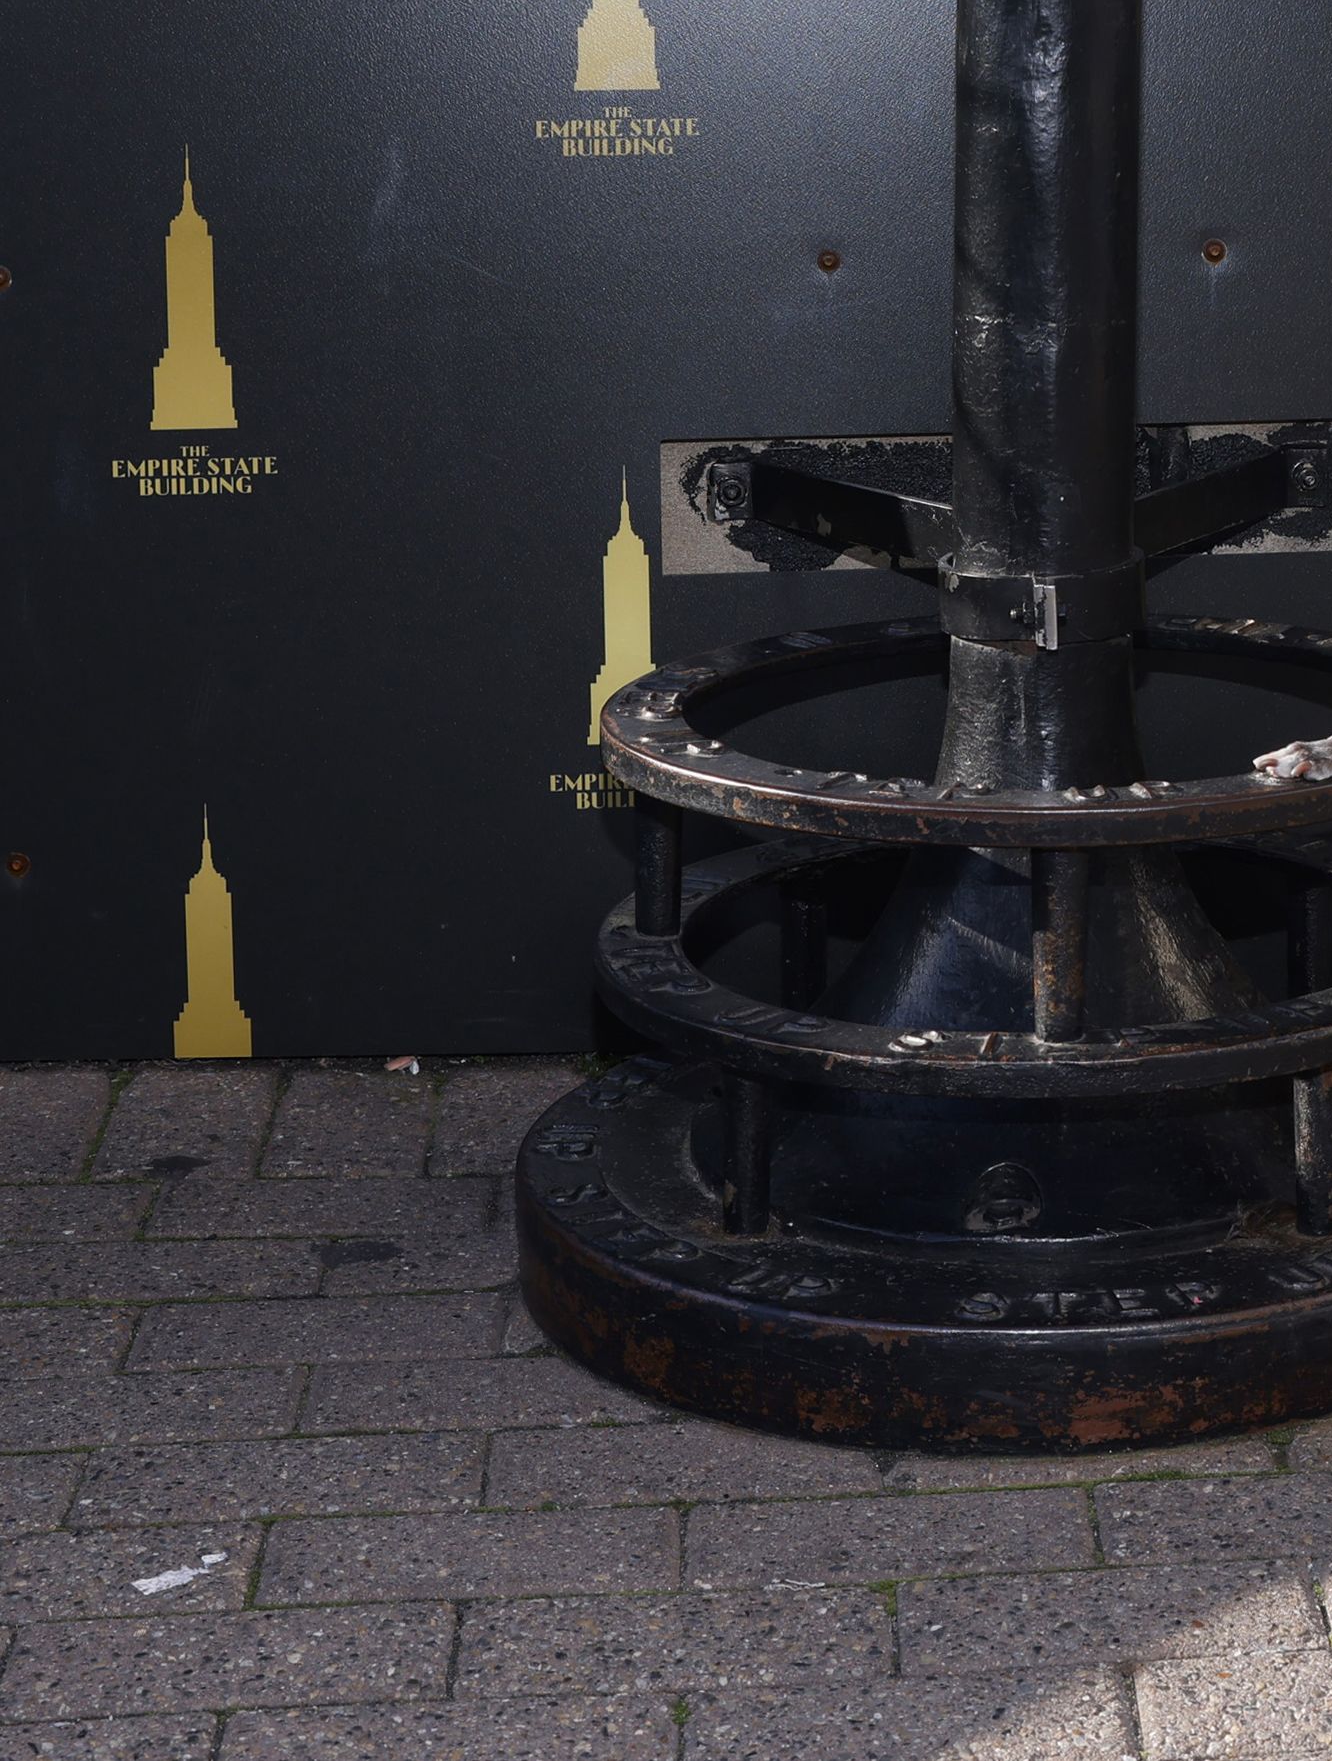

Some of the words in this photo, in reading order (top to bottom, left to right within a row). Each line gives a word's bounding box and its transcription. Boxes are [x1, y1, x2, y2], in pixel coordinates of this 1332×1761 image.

[603, 106, 632, 118] THE
[535, 119, 622, 138] EMPIRE
[630, 117, 701, 136] STATE
[562, 137, 673, 157] BUILDING
[180, 445, 210, 457] THE
[112, 458, 200, 478] EMPIRE
[207, 456, 278, 475] STATE
[140, 476, 252, 496] BUILDING
[549, 772, 630, 792] EMPIR
[576, 790, 636, 810] BUIL
[952, 1279, 1222, 1322] STEP
